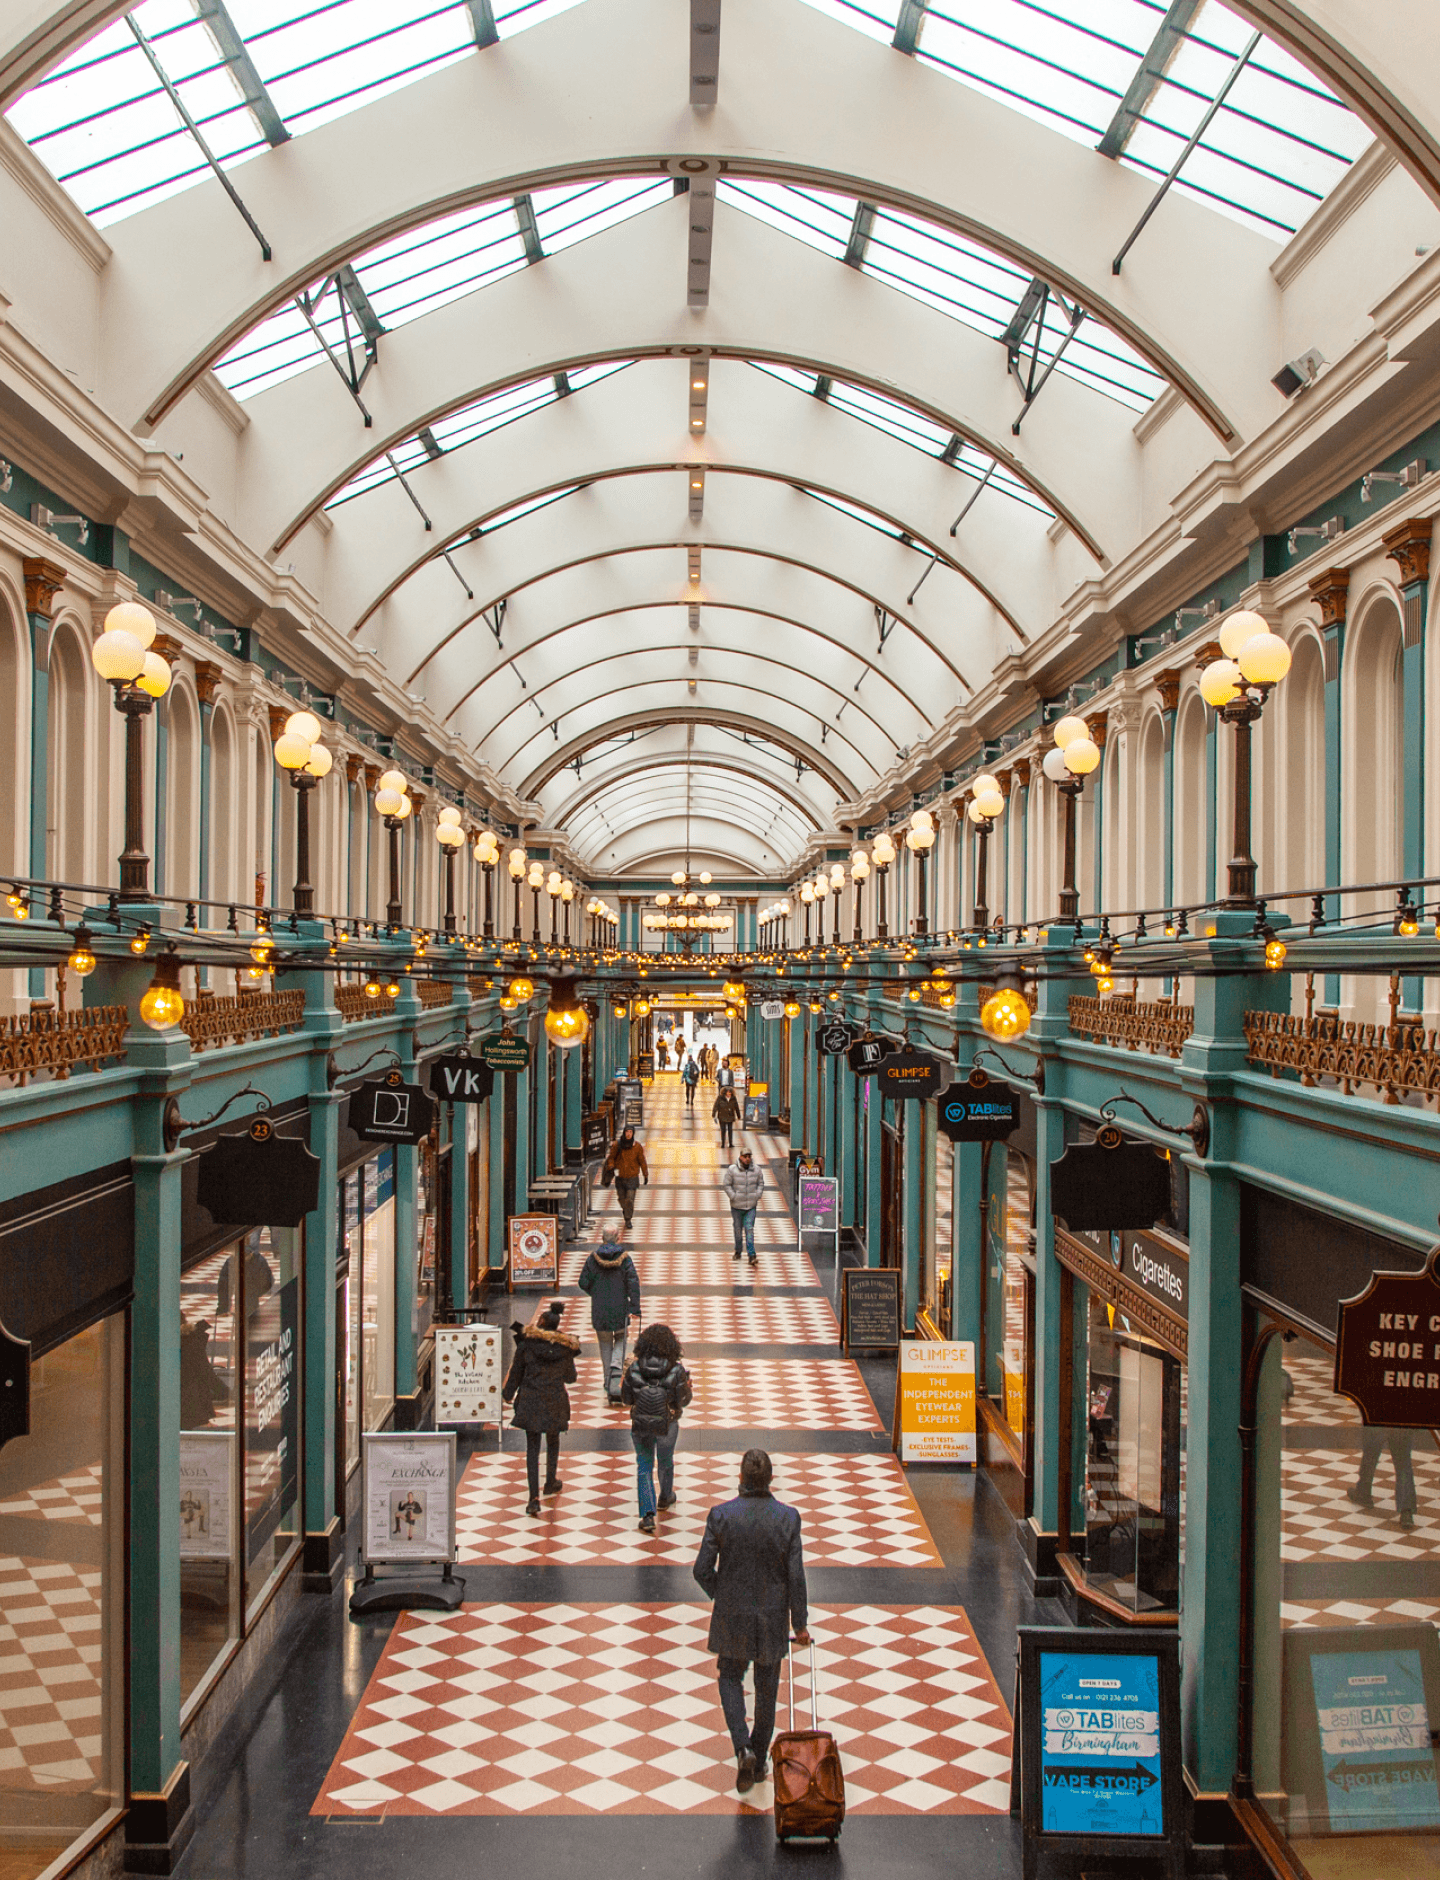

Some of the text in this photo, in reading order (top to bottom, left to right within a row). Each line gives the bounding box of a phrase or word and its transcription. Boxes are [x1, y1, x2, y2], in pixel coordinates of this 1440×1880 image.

[484, 1046, 527, 1056] Hollingsworth
[389, 1074, 399, 1083] 25
[887, 1067, 931, 1078] GLIMPSE
[253, 1124, 268, 1137] 23
[1104, 1131, 1117, 1143] 20
[799, 1166, 819, 1175] Gym
[1132, 1243, 1182, 1301] Cigarettes
[1379, 1313, 1419, 1331] KEY
[279, 1328, 291, 1355] AND
[908, 1348, 968, 1361] GLIMPSE
[1369, 1341, 1424, 1360] SHOE
[254, 1351, 293, 1409] RESTAURANT
[929, 1378, 947, 1386] THE
[904, 1390, 974, 1399] INDEPENDENT
[916, 1402, 962, 1411] EYEWEAR
[918, 1415, 960, 1423] EXPERTS
[391, 1469, 446, 1478] EXCHANGE
[1076, 1711, 1145, 1730] TABlites
[1062, 1728, 1140, 1755] Birmingham
[1044, 1774, 1151, 1790] VAPE STORE
